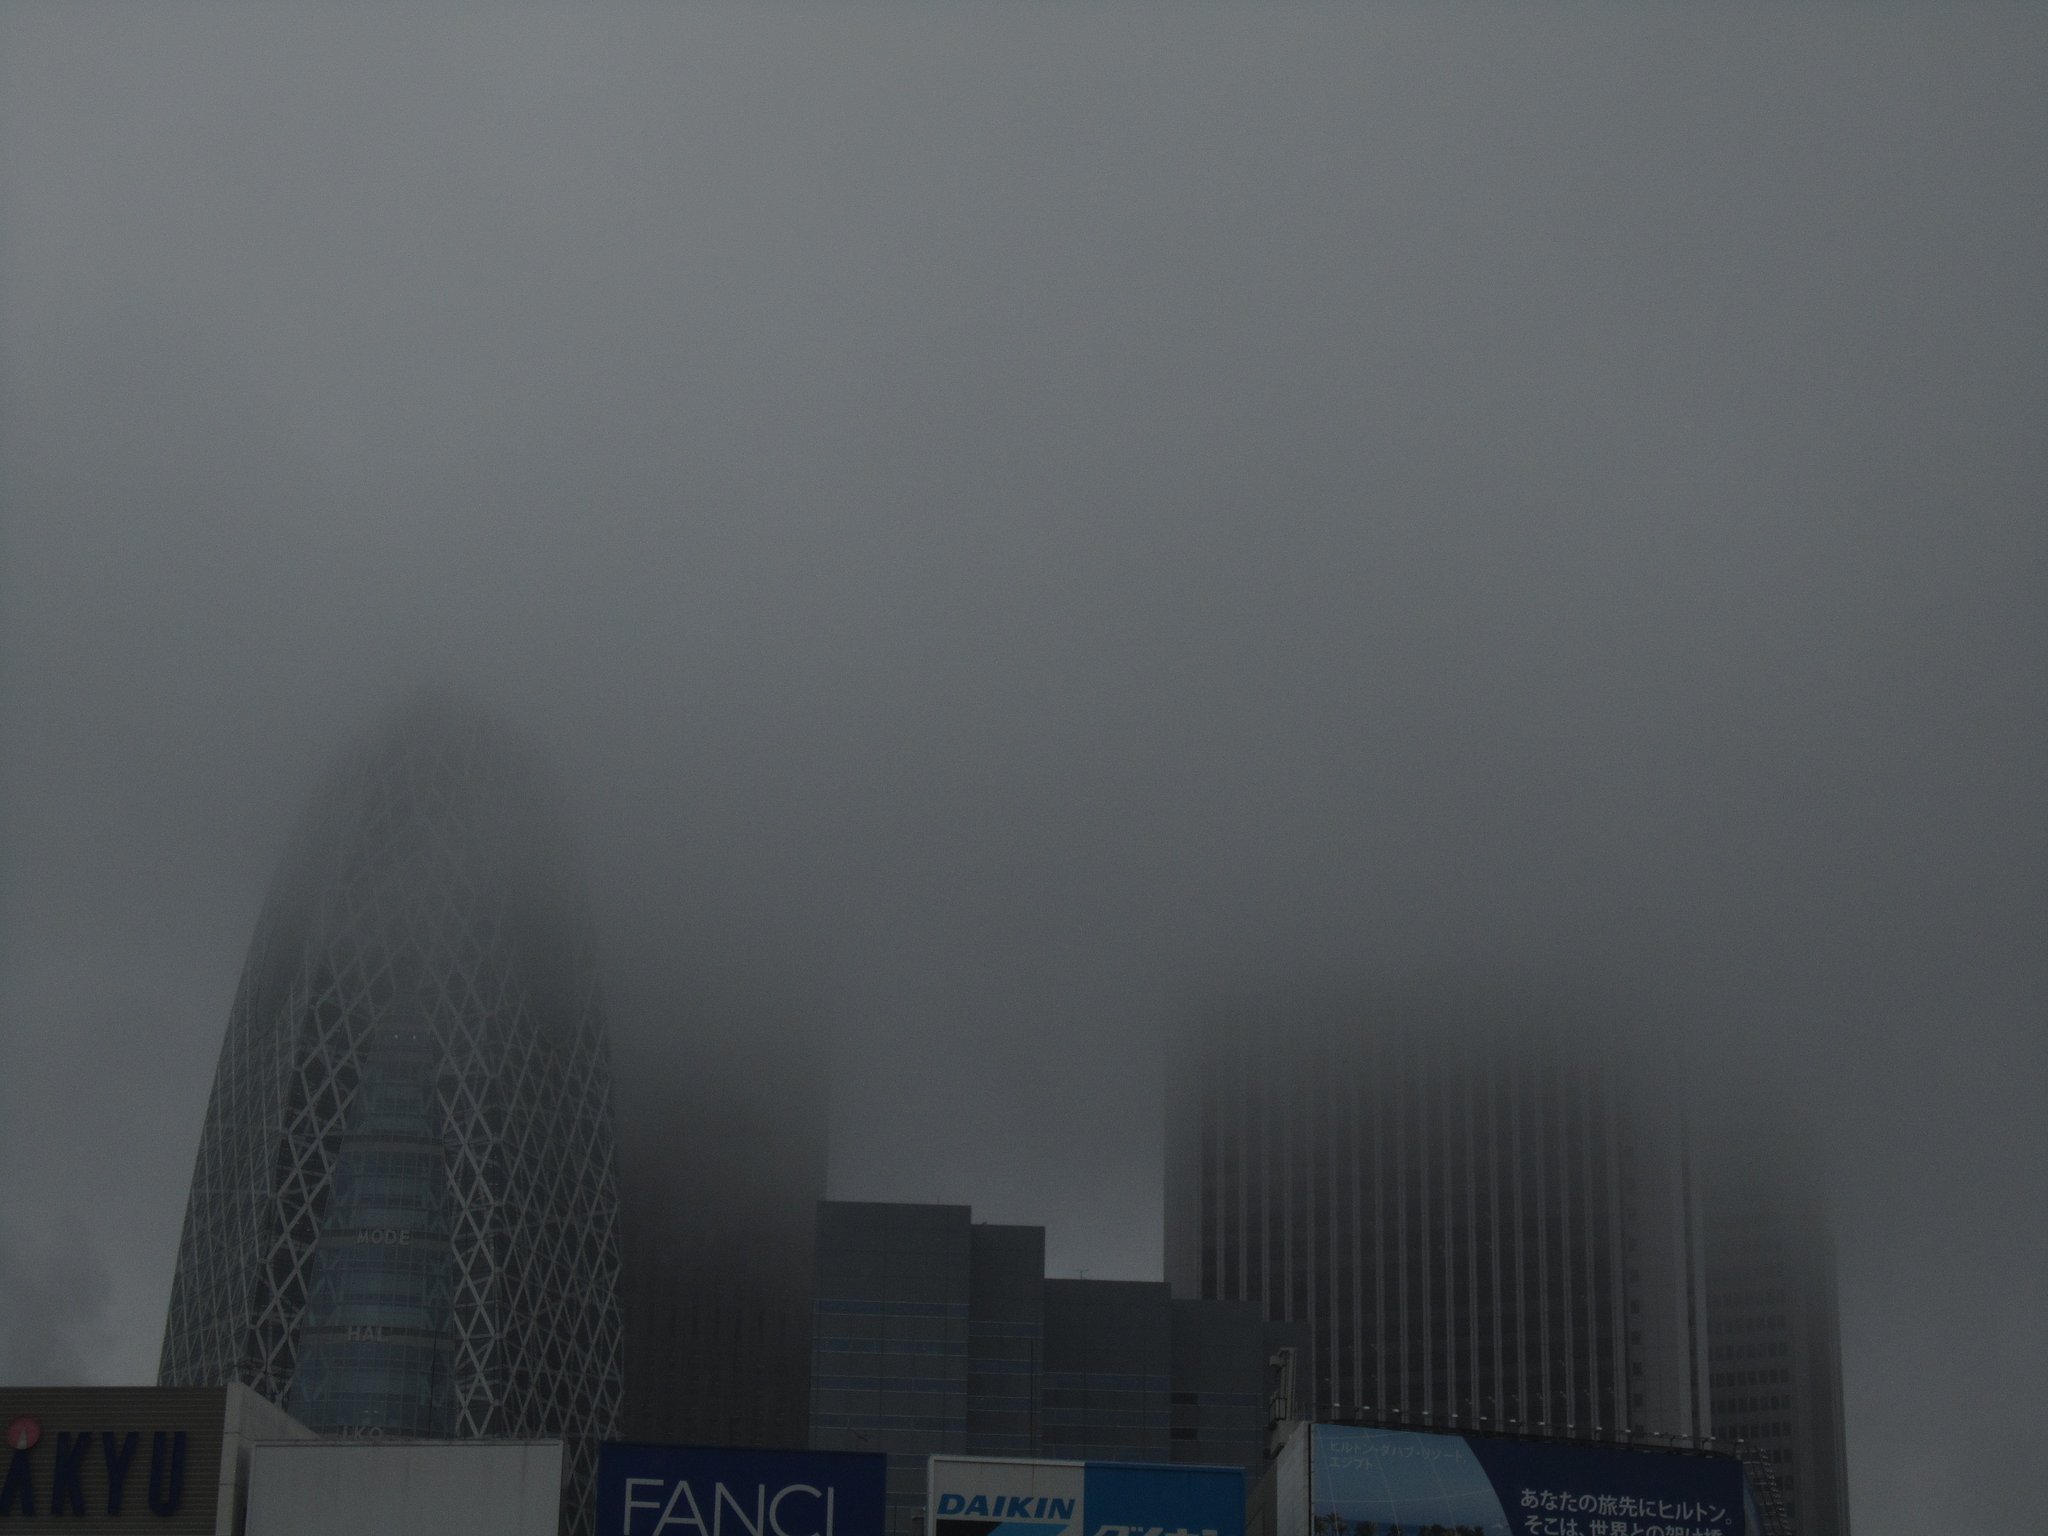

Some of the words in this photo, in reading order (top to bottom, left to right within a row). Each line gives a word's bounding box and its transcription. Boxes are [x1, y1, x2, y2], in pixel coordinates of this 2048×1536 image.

[357, 1229, 412, 1246] MODE
[347, 1325, 389, 1343] HAL
[936, 1493, 1075, 1519] DAIKIN
[1520, 1488, 1733, 1526] あなたの旅先にヒルトン。
